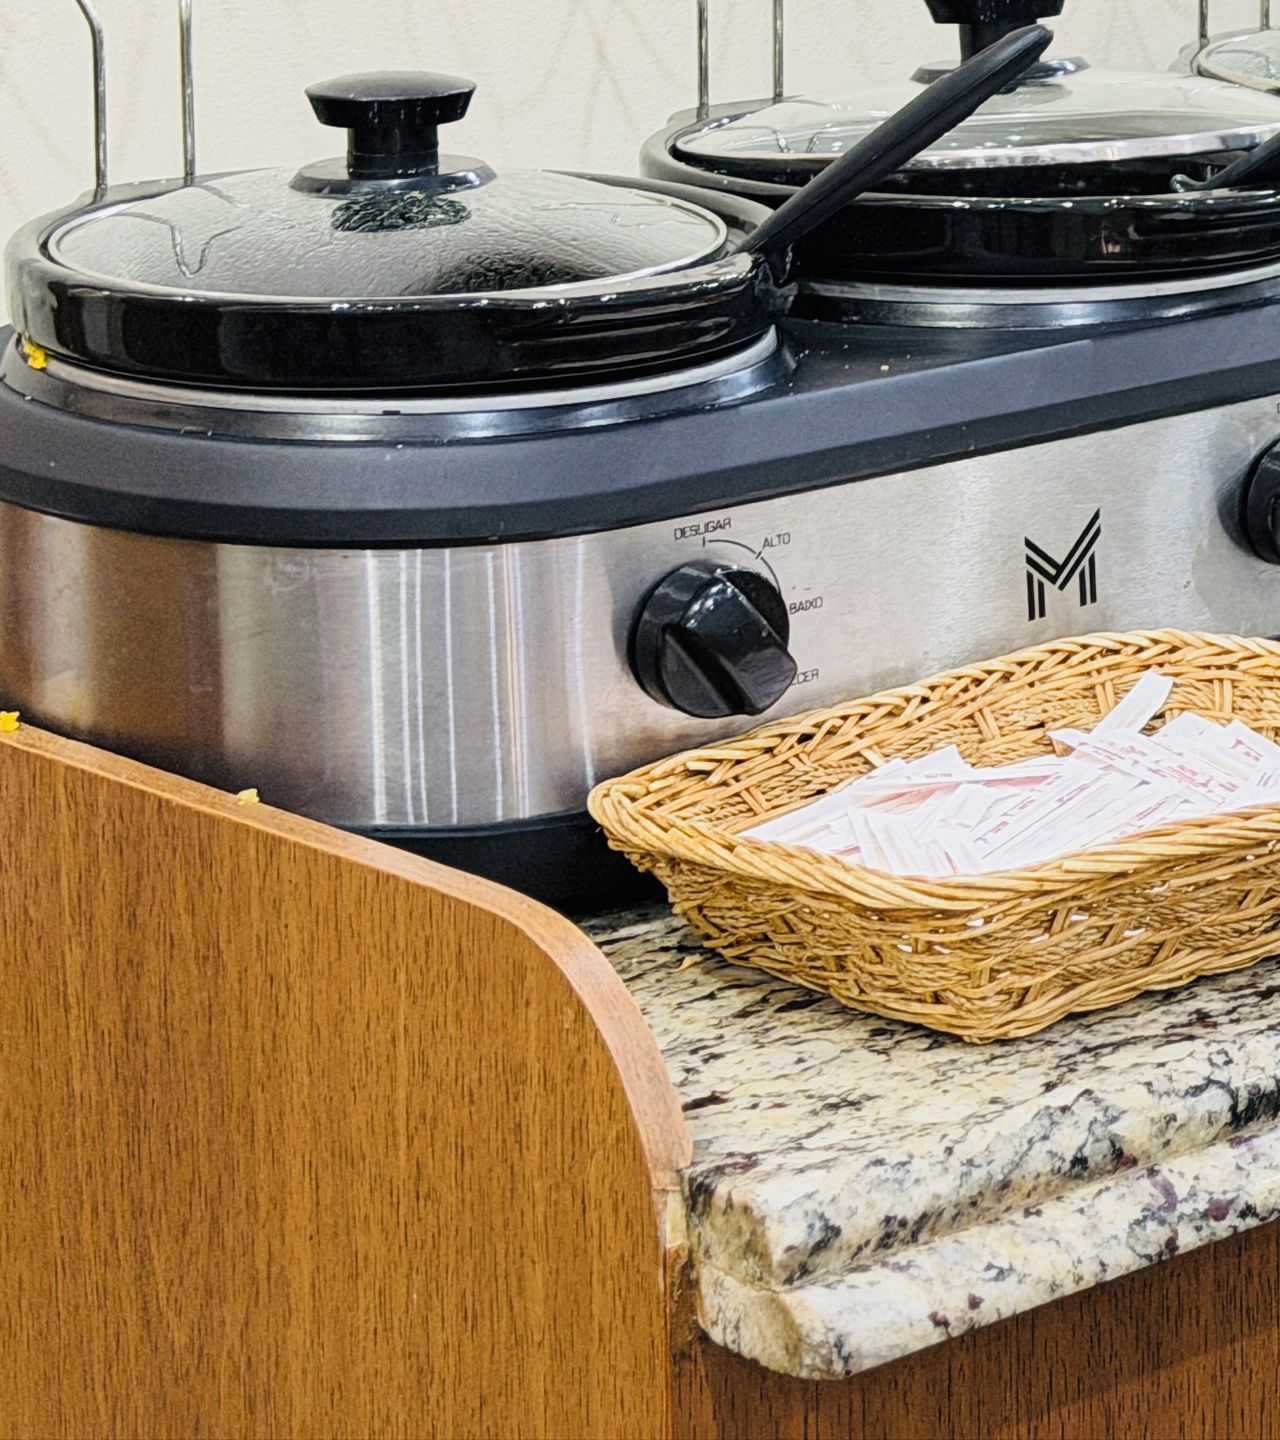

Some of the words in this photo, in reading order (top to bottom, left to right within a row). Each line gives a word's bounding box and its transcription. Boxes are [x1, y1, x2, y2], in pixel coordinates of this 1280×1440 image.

[673, 517, 733, 541] DESLIGAR
[761, 532, 792, 550] ALTO
[788, 595, 824, 615] BAIXO
